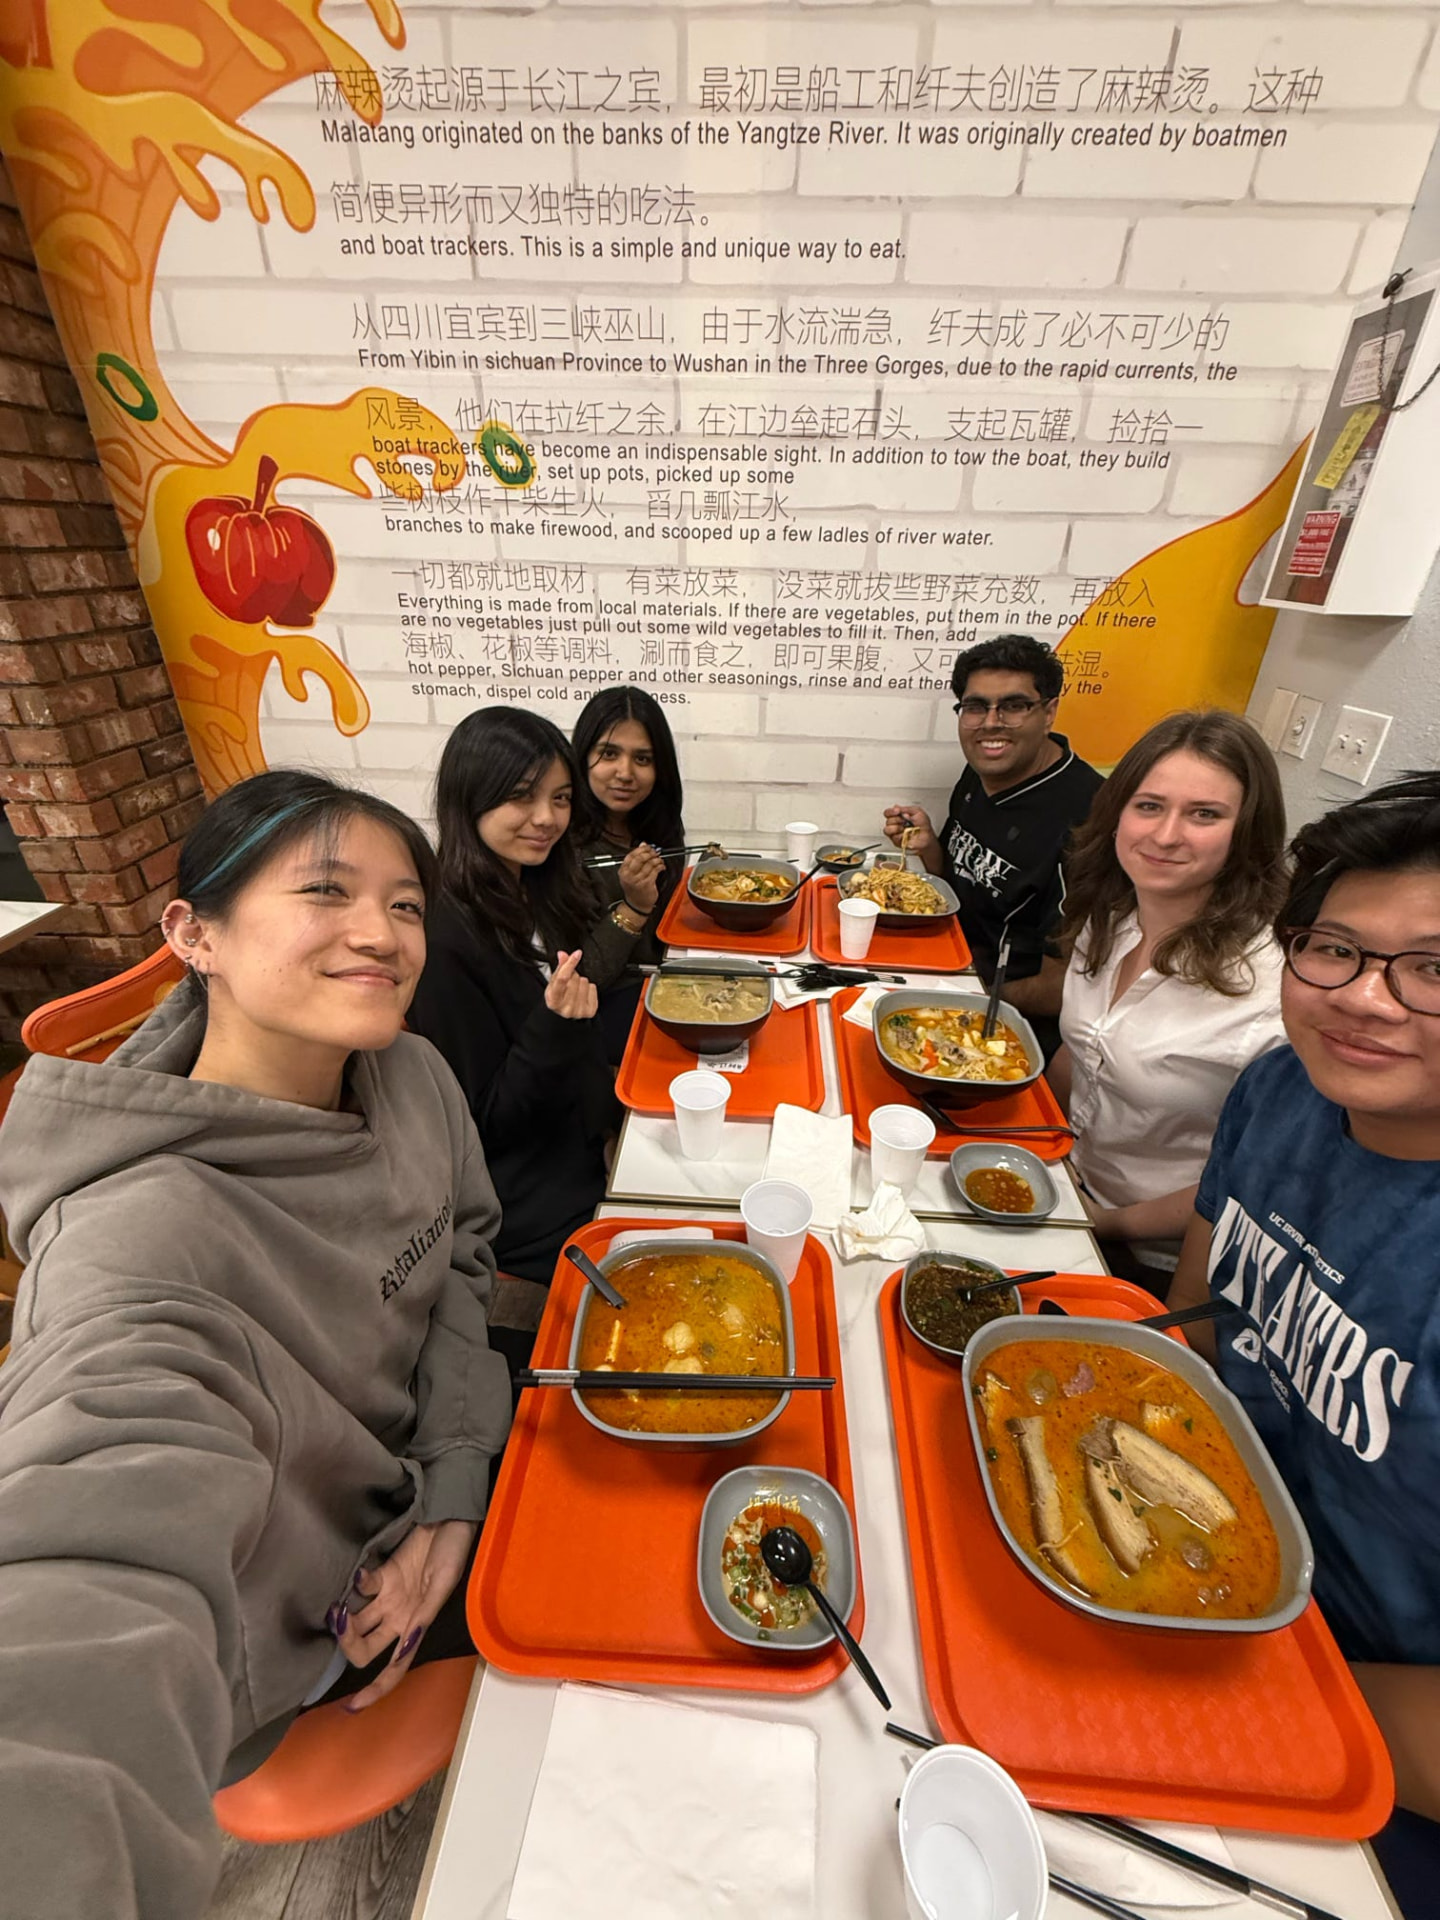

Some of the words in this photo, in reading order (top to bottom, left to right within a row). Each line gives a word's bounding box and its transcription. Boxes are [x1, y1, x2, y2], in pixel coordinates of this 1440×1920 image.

[322, 120, 414, 148] Malatang
[422, 120, 523, 149] originated
[531, 126, 555, 144] on
[562, 121, 594, 145] the
[602, 121, 663, 145] banks
[671, 121, 691, 145] of
[697, 121, 729, 144] the
[737, 120, 820, 150] Yangtze
[829, 121, 887, 144] River.
[898, 120, 911, 144] It
[918, 126, 959, 144] was
[967, 121, 1065, 151] originally
[1071, 122, 1154, 146] created
[1159, 122, 1187, 152] by
[1192, 122, 1287, 147] boatmen
[340, 234, 375, 255] and
[381, 234, 425, 255] boat
[431, 235, 514, 257] trackers.
[520, 235, 562, 257] This
[569, 236, 585, 257] is
[592, 241, 603, 258] a
[611, 236, 674, 263] simple
[681, 236, 716, 258] and
[725, 236, 790, 263] unique
[798, 242, 837, 264] way
[844, 238, 862, 258] to
[870, 238, 905, 259] eat.
[358, 348, 406, 368] From
[410, 349, 456, 369] Yibin
[462, 350, 478, 370] in
[486, 352, 555, 371] sichuan
[563, 352, 643, 371] Province
[650, 354, 667, 372] to
[673, 353, 748, 373] Wushan
[755, 353, 771, 373] in
[778, 354, 807, 373] the
[814, 354, 868, 374] Three
[875, 354, 948, 379] Gorges,
[957, 356, 992, 376] due
[999, 358, 1017, 376] to
[1024, 357, 1053, 377] the
[1060, 359, 1110, 382] rapid
[1115, 361, 1198, 383] currents,
[1207, 361, 1237, 381] the
[372, 436, 410, 454] boat
[417, 437, 487, 456] trackers
[493, 438, 535, 457] have
[541, 440, 611, 459] become
[617, 446, 638, 460] an
[645, 442, 767, 466] indispensable
[774, 444, 821, 467] sight.
[830, 445, 845, 463] In
[852, 446, 923, 464] addition
[931, 448, 947, 465] to
[954, 447, 986, 465] tow
[992, 448, 1020, 465] the
[1026, 448, 1071, 470] boat,
[1079, 449, 1120, 473] they
[1124, 450, 1171, 468] build
[377, 457, 433, 475] stones
[440, 459, 459, 480] by
[466, 460, 491, 477] the
[547, 464, 574, 480] set
[580, 467, 601, 485] up
[607, 465, 649, 485] pots,
[656, 465, 712, 486] picked
[720, 470, 740, 487] up
[747, 470, 794, 483] some
[385, 515, 463, 533] branches
[468, 518, 484, 534] to
[490, 518, 535, 535] make
[540, 519, 617, 540] firewood,
[624, 521, 655, 538] and
[661, 522, 733, 543] scooped
[740, 526, 760, 544] up
[766, 527, 776, 540] a
[782, 524, 813, 541] few
[818, 525, 869, 543] ladles
[875, 527, 893, 543] of
[897, 527, 937, 544] river
[942, 528, 993, 545] water.
[398, 592, 482, 614] Everything
[488, 595, 502, 610] is
[508, 596, 552, 612] made
[557, 597, 593, 613] from
[599, 599, 636, 615] local
[643, 600, 722, 617] materials.
[729, 602, 740, 617] If
[745, 603, 786, 619] there
[792, 607, 819, 619] are
[825, 605, 919, 624] vegetables,
[925, 608, 954, 626] put
[958, 608, 999, 624] them
[1005, 609, 1020, 624] in
[1026, 609, 1052, 625] the
[1057, 611, 1089, 629] pot.
[1096, 611, 1109, 626] If
[1113, 611, 1156, 627] there
[401, 614, 426, 626] are
[432, 615, 452, 627] no
[456, 614, 543, 632] vegetables
[548, 616, 577, 635] just
[583, 617, 611, 636] pull
[616, 619, 642, 633] out
[647, 622, 690, 635] some
[695, 621, 727, 636] wild
[733, 622, 821, 640] vegetables
[828, 624, 841, 638] to
[849, 624, 867, 639] fill
[872, 625, 886, 639] it.
[894, 625, 939, 644] Then,
[946, 627, 977, 641] add
[408, 659, 433, 674] hot
[438, 663, 496, 680] pepper,
[501, 662, 563, 679] Sichuan
[569, 667, 626, 685] pepper
[628, 667, 657, 682] and
[663, 668, 704, 683] other
[708, 671, 802, 691] seasonings,
[809, 672, 847, 687] rinse
[853, 674, 883, 688] and
[888, 675, 914, 689] eat
[1077, 680, 1102, 694] the
[412, 681, 481, 700] stomach,
[486, 683, 531, 702] dispel
[537, 685, 568, 700] cold
[1268, 1212, 1285, 1228] UC
